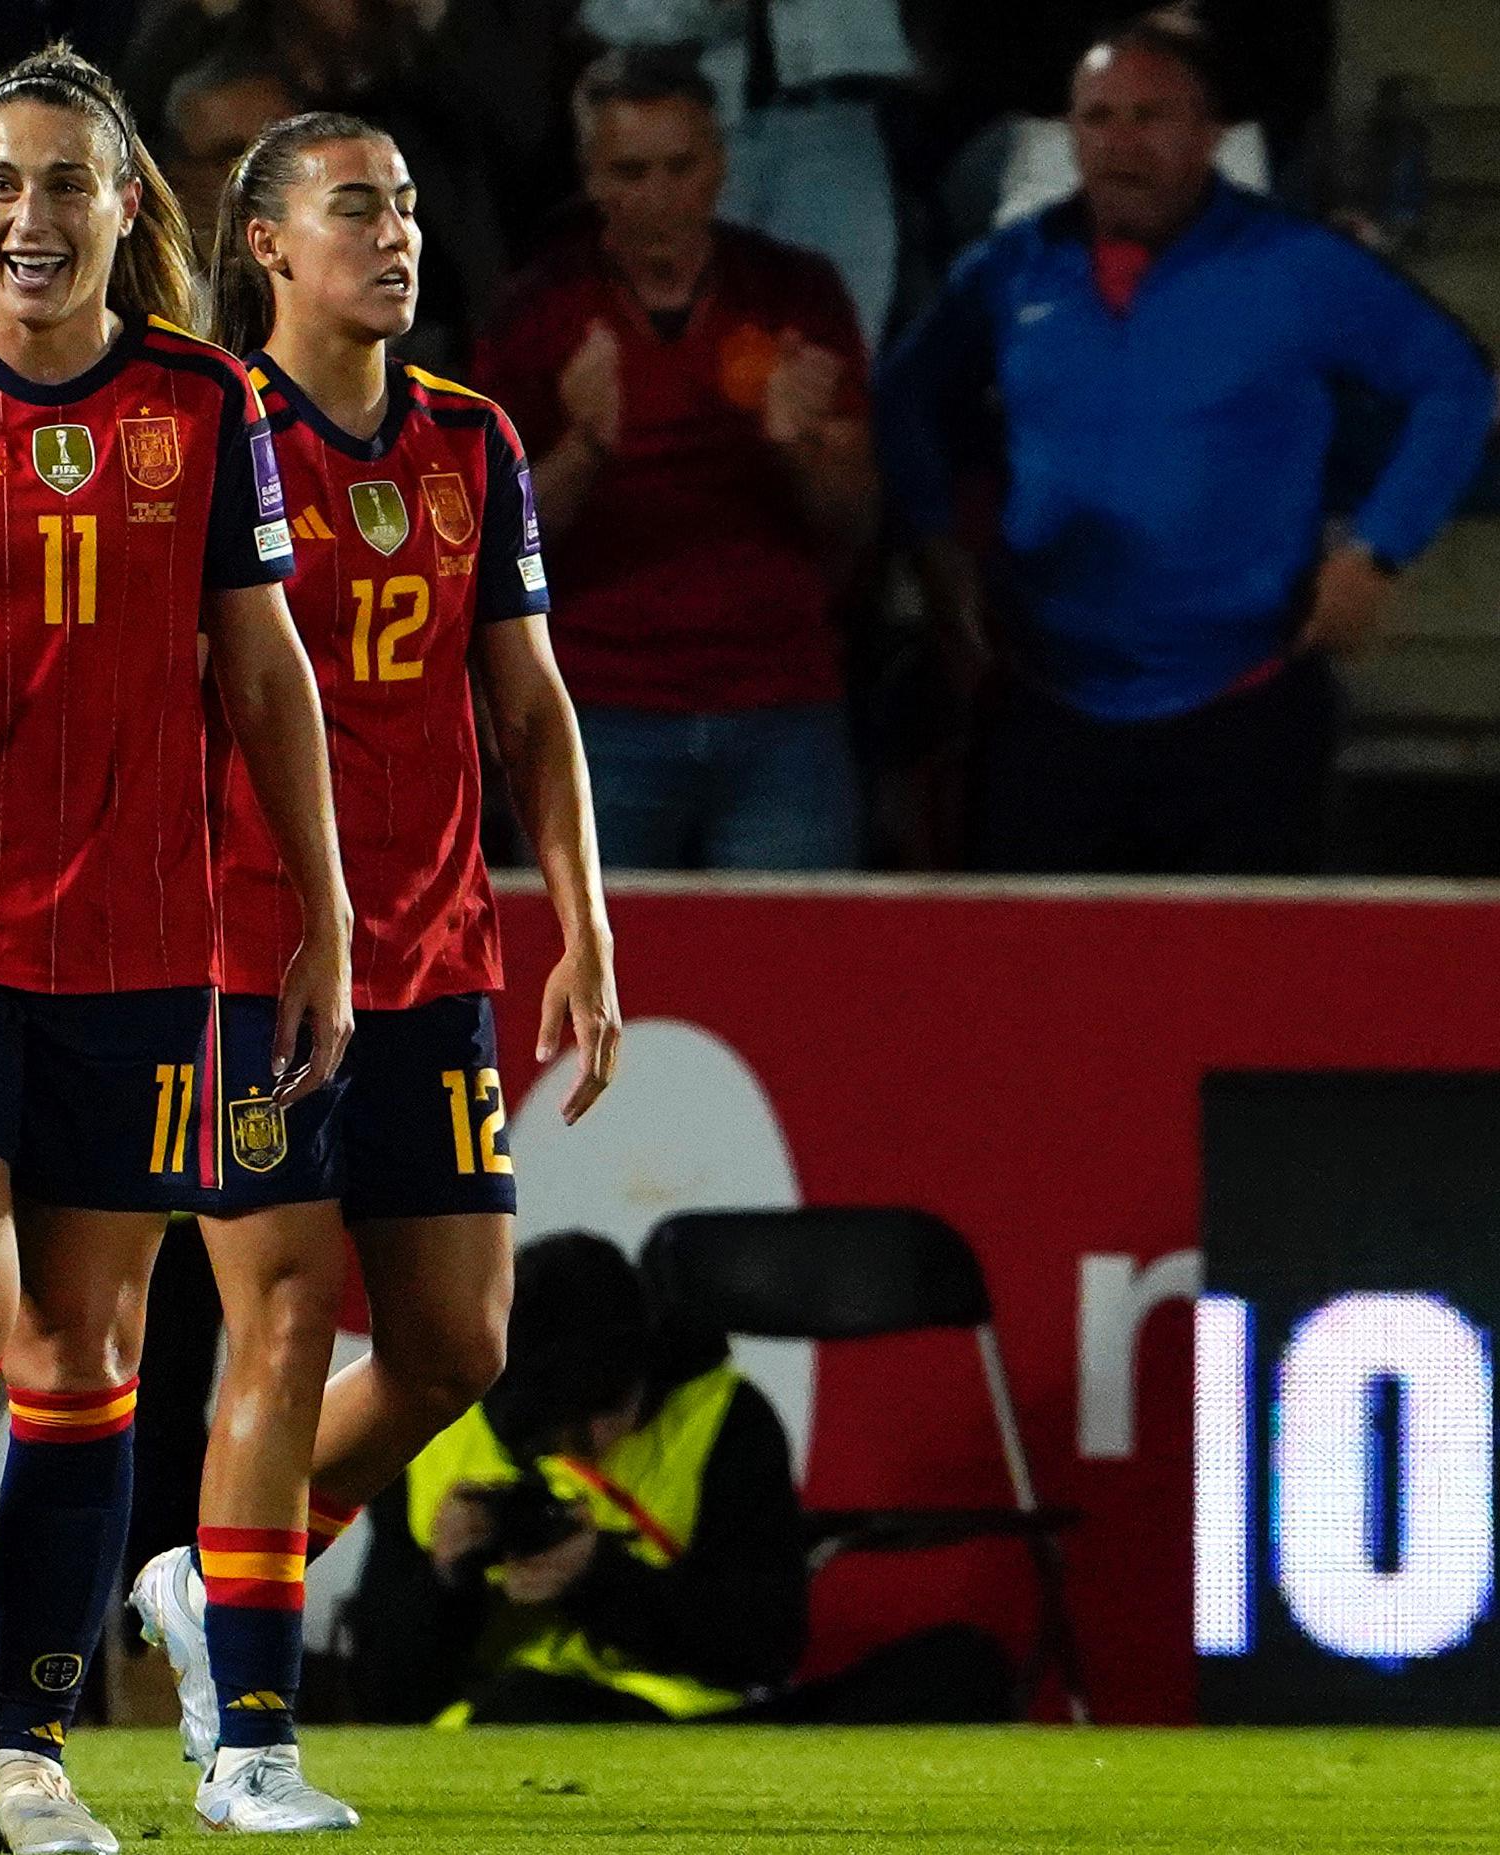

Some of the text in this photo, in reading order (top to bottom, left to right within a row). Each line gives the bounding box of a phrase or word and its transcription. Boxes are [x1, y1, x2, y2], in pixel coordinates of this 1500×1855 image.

[38, 515, 98, 625] 11
[351, 575, 430, 682] 12
[149, 1063, 195, 1174] 11
[441, 1067, 514, 1175] 12
